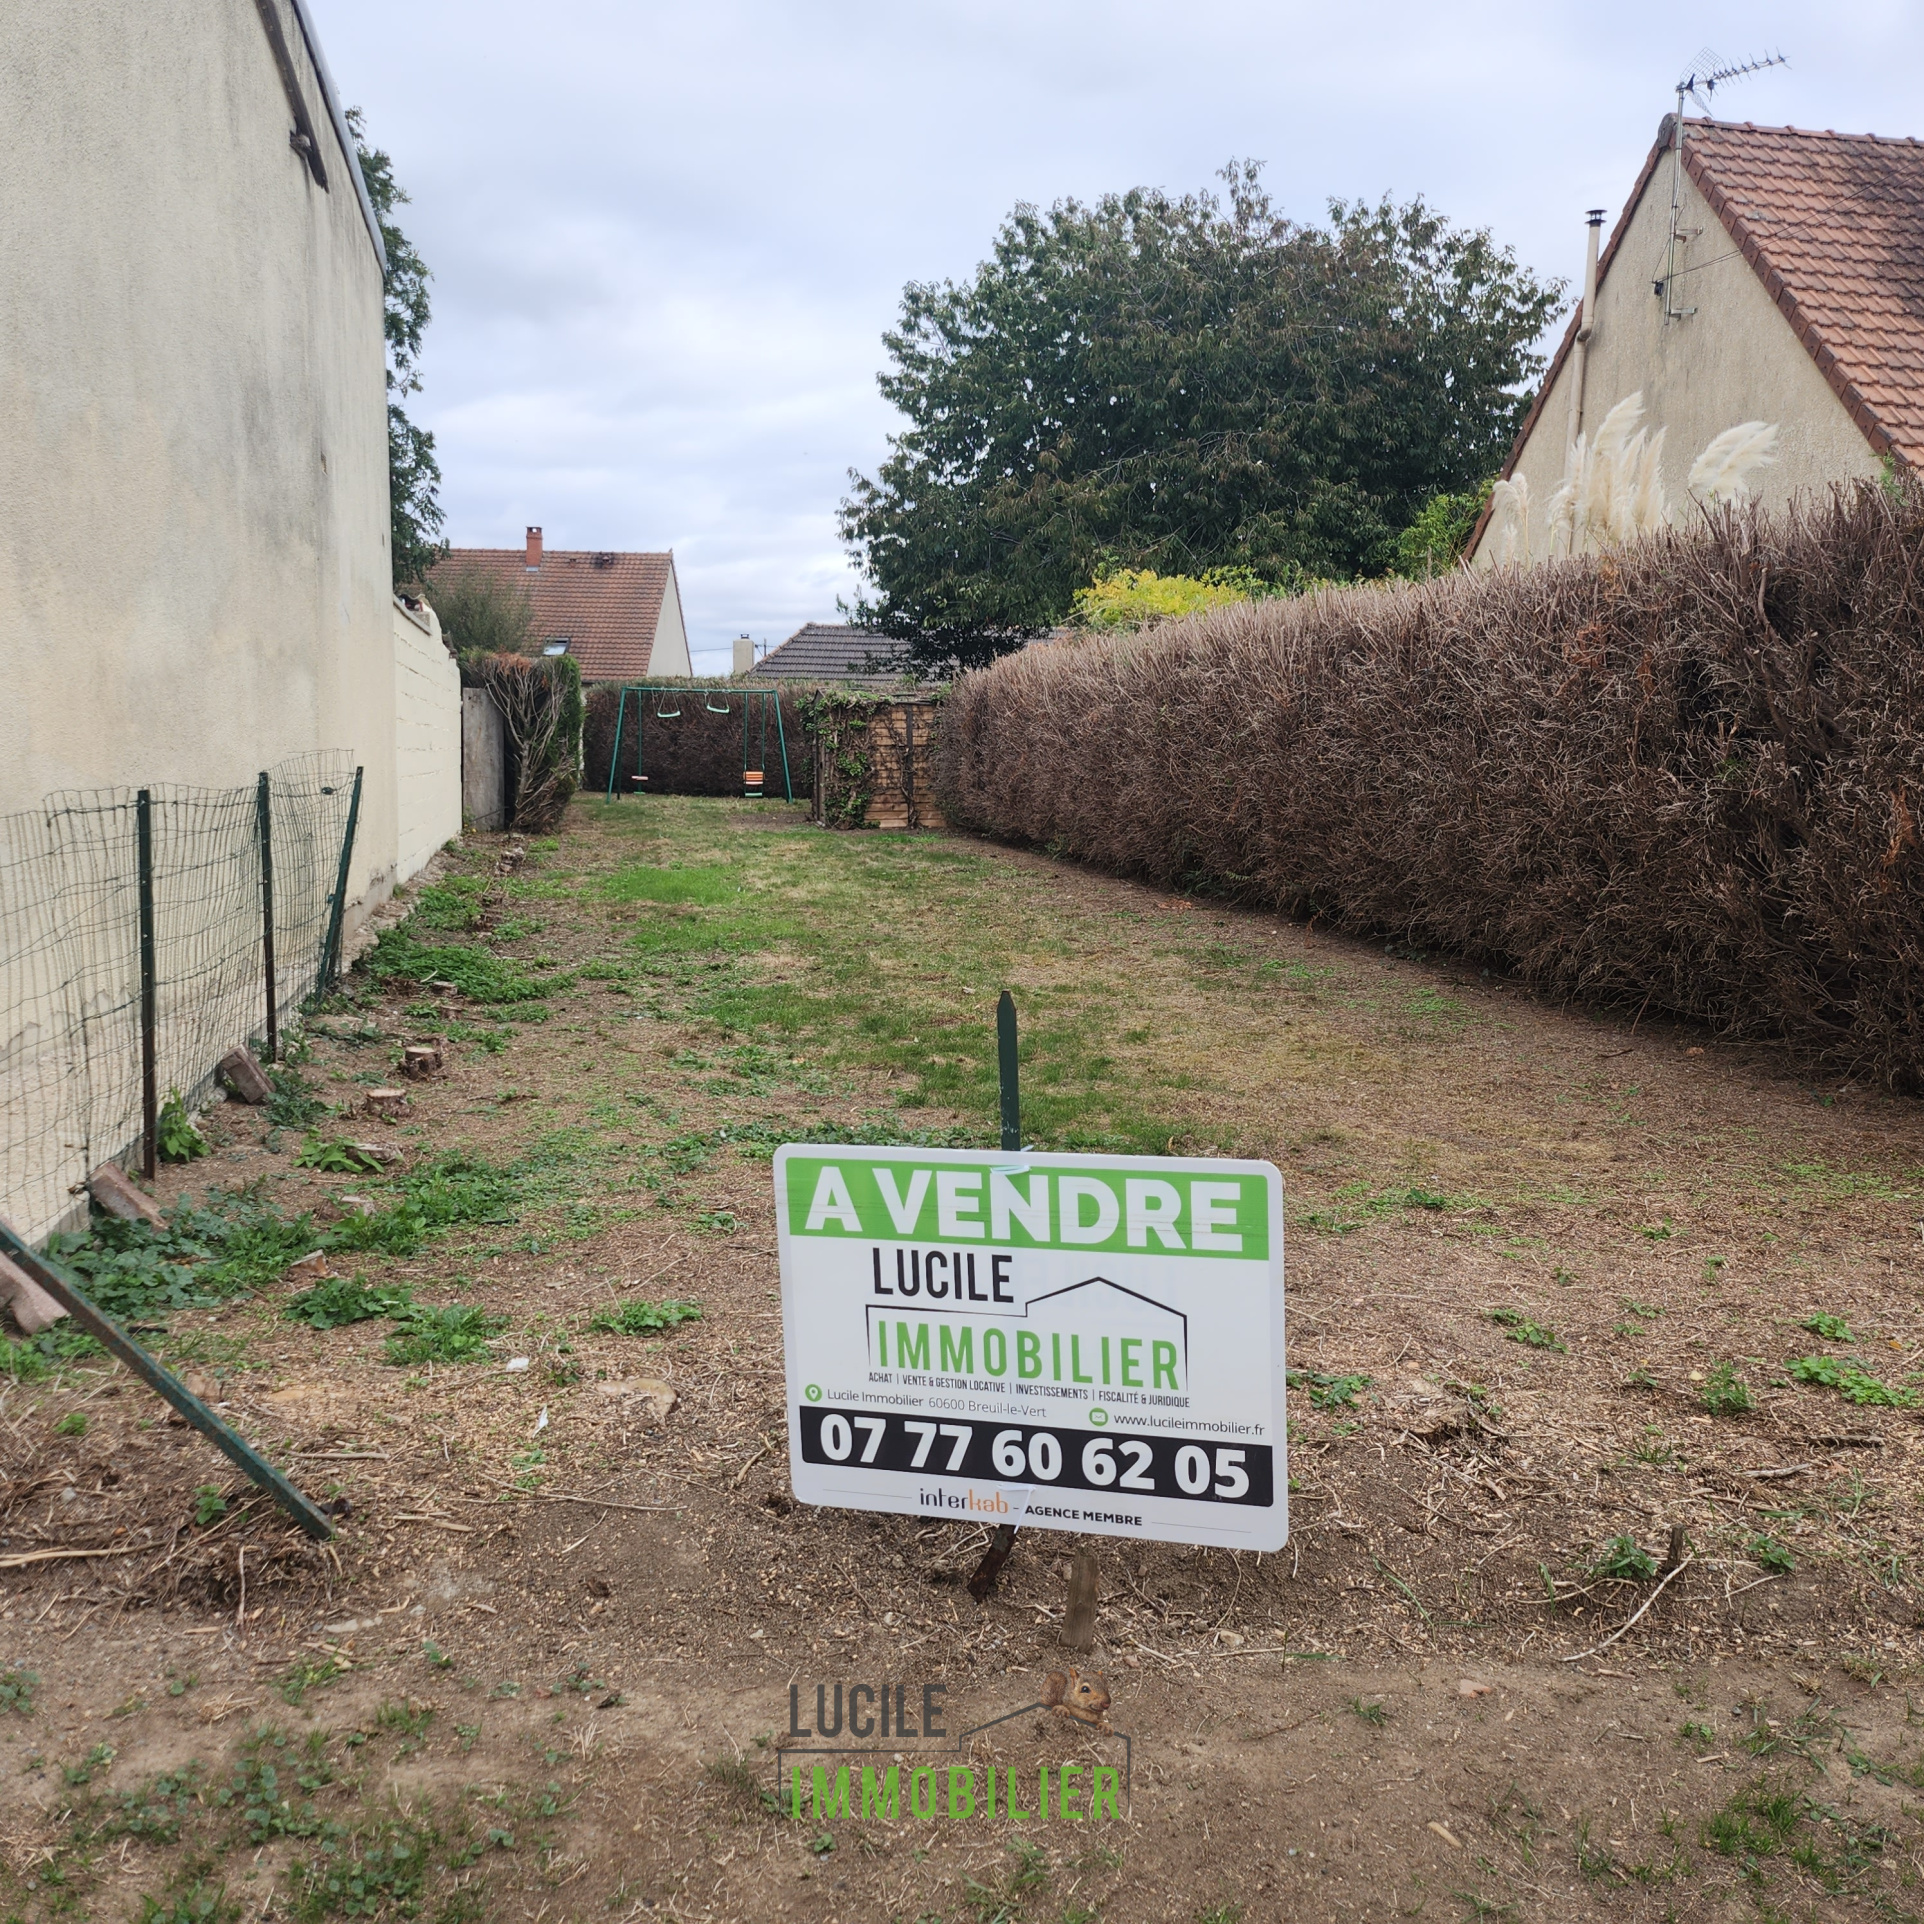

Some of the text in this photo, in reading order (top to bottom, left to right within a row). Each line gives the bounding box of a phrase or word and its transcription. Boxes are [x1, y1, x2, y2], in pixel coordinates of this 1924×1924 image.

[804, 1165, 1244, 1252] A VENDRE
[872, 1247, 1014, 1303] LUCILE
[877, 1320, 1180, 1391] IMMOBILIER
[827, 1388, 1047, 1417] Lucile Immobilier 60600 Breuil-le-Vert
[868, 1372, 892, 1384] ACHAT
[902, 1375, 927, 1387] VENTE
[935, 1377, 968, 1390] GESTION
[969, 1380, 1006, 1393] LOCATIVE
[1015, 1383, 1088, 1400] INVESTISSEMENTS
[1098, 1390, 1139, 1404] FISCALITÉ
[1148, 1394, 1190, 1408] JURIDIQUE
[1113, 1414, 1266, 1435] www.lucileimmobilier.fr
[820, 1413, 1250, 1498] 07 77 60 62 05
[1024, 1504, 1080, 1520] AGENCE
[1083, 1511, 1143, 1527] MEMBRE
